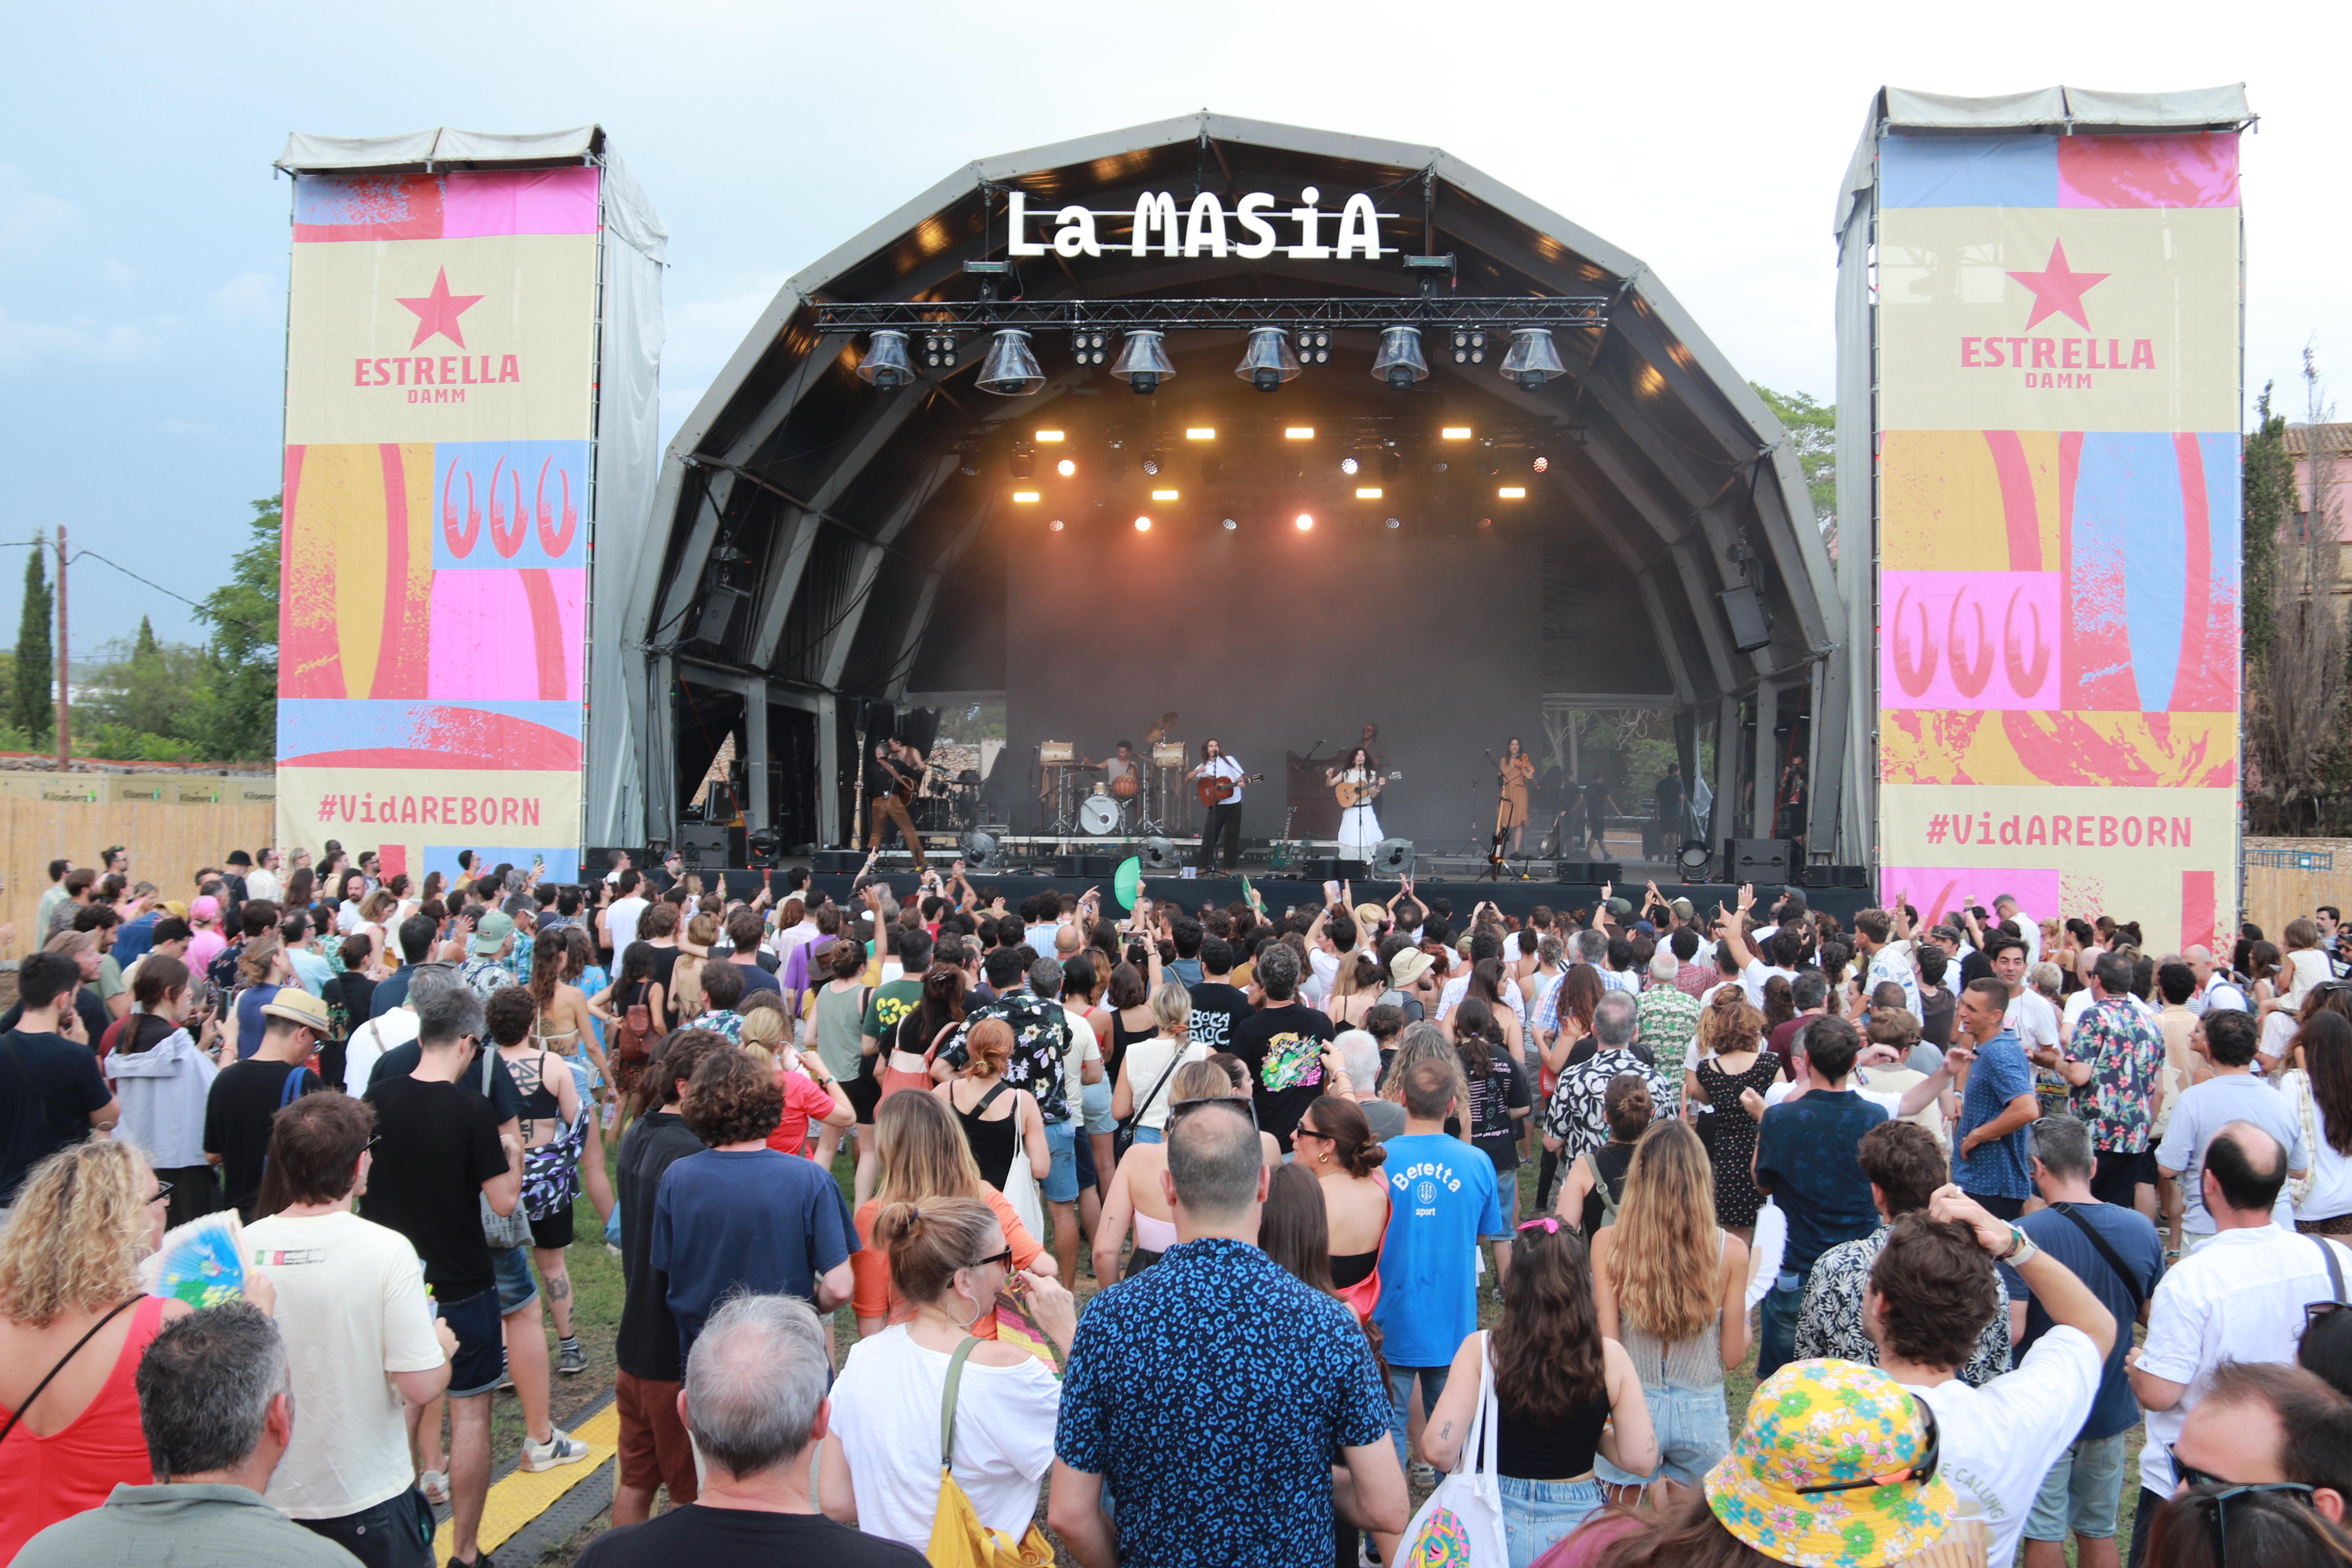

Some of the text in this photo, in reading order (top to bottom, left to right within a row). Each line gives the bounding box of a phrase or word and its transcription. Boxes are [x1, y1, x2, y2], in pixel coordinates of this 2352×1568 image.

[1008, 186, 1380, 260] La MASiA
[1960, 336, 2156, 369] ESTRELLA
[354, 354, 521, 387] ESTRELLA
[2025, 372, 2092, 389] DAMM
[407, 388, 466, 404] DAMM
[317, 791, 539, 826] #VidAREBORN
[1926, 811, 2192, 848] #VidAREBORN
[1391, 1163, 1461, 1193] Beretta
[1415, 1207, 1436, 1218] sport
[1955, 1468, 2005, 1520] CALLING
